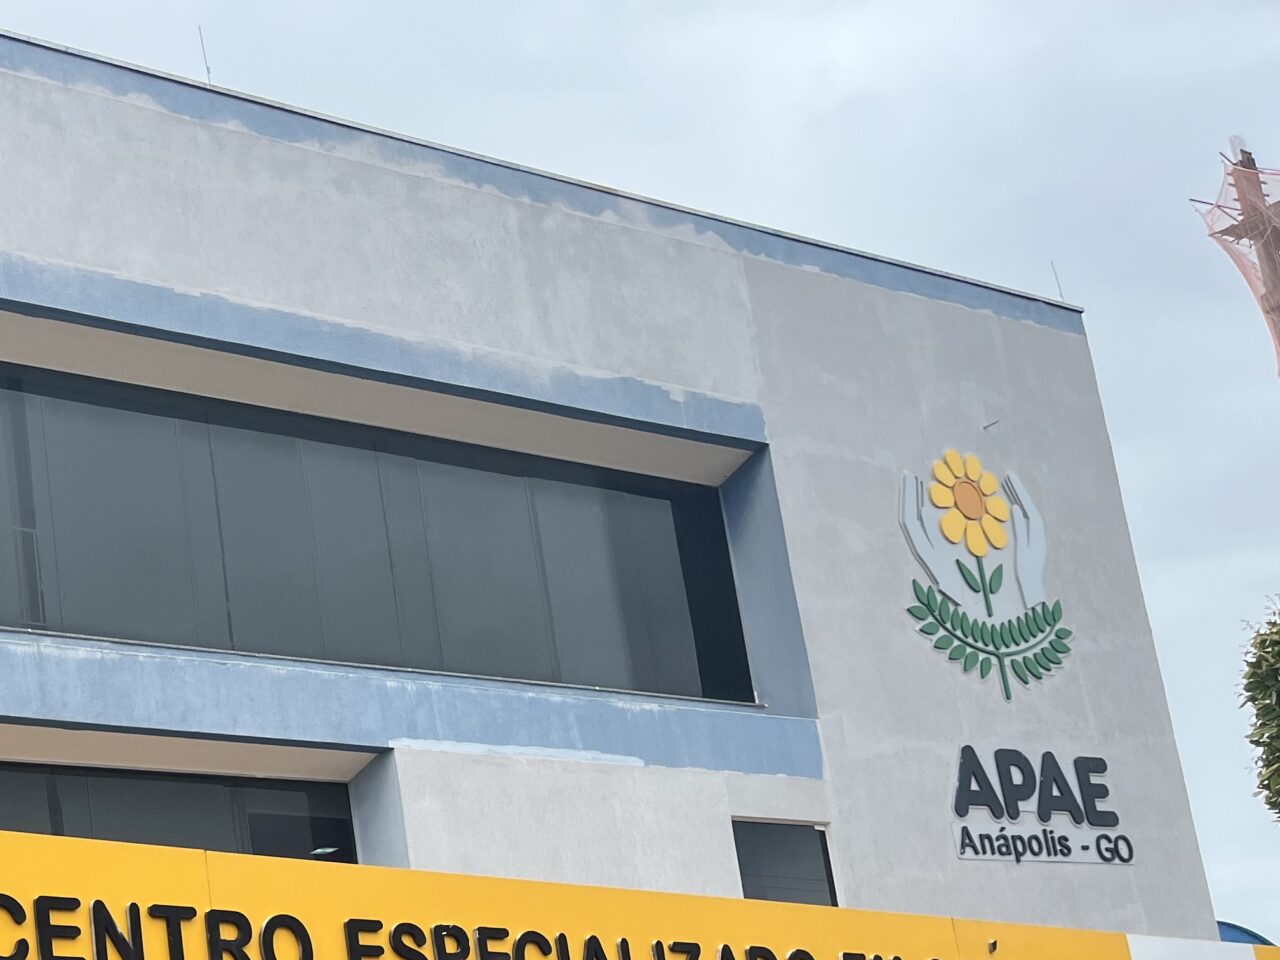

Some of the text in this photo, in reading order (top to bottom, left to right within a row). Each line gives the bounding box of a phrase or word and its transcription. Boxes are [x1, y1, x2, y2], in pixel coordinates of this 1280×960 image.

[955, 745, 1119, 827] APAE
[960, 826, 1072, 863] Anápolis
[1095, 833, 1134, 863] GO
